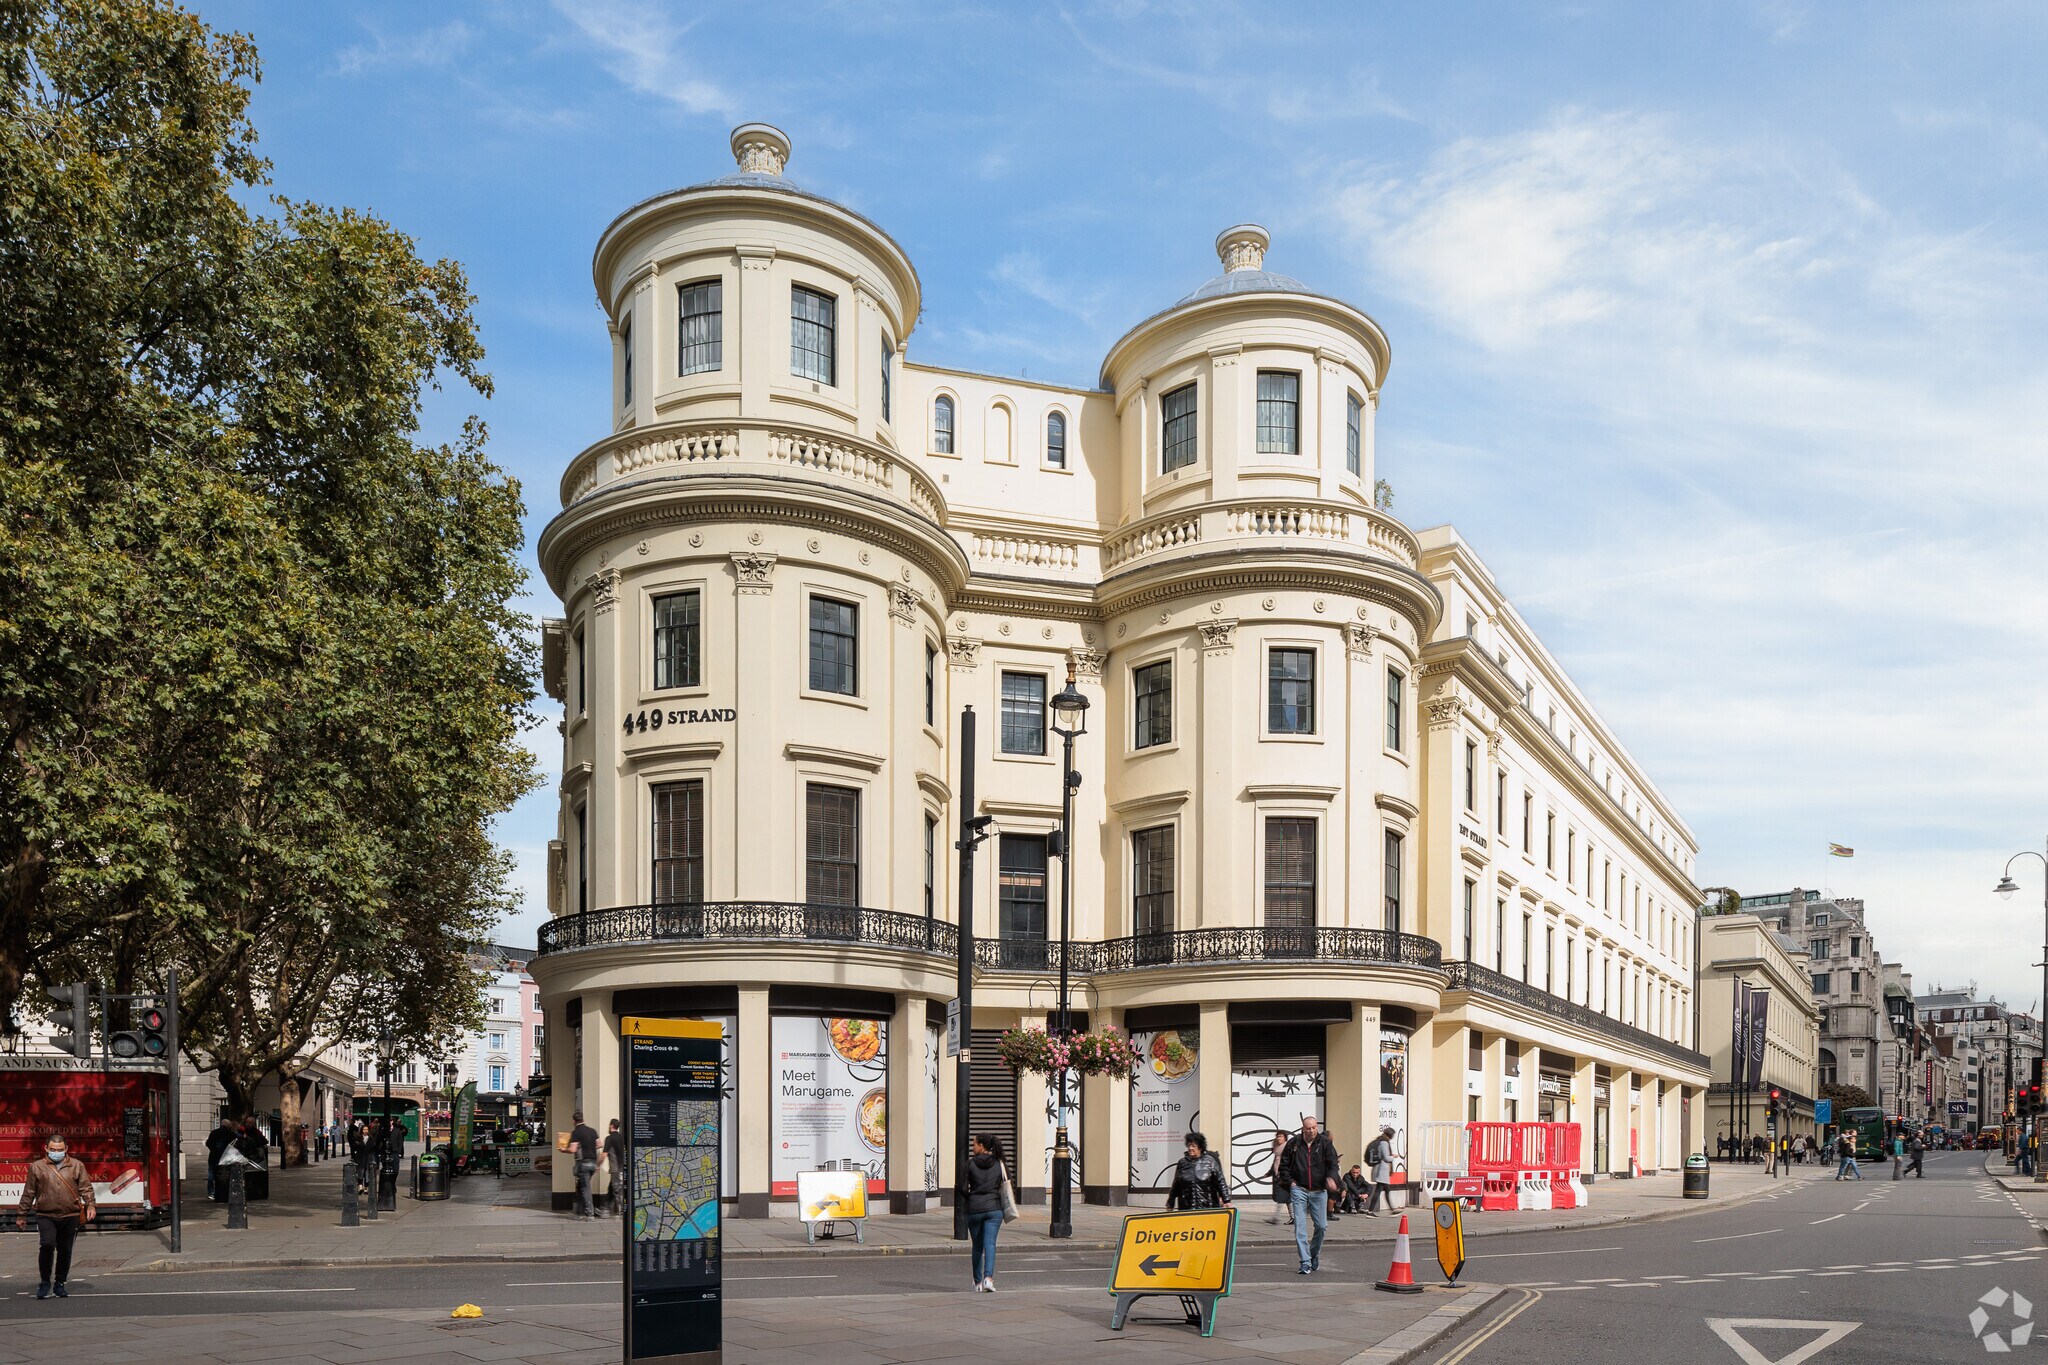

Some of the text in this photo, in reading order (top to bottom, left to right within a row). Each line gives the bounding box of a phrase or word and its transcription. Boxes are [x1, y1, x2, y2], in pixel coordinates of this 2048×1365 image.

[622, 708, 736, 734] 449 STRAND
[1751, 1032, 1762, 1062] Coutts
[0, 1058, 30, 1068] AND
[34, 1058, 99, 1068] SAUSAGE
[782, 1070, 816, 1081] Meet
[782, 1085, 854, 1099] Marugame.
[1137, 1101, 1181, 1113] Join the
[1388, 1108, 1397, 1118] the
[457, 1094, 470, 1150] SUBWAY
[1137, 1116, 1162, 1126] club!
[29, 1127, 70, 1135] SCOOPED
[71, 1127, 86, 1135] ICE
[88, 1127, 119, 1135] CREAM
[1134, 1228, 1216, 1244] Diversion
